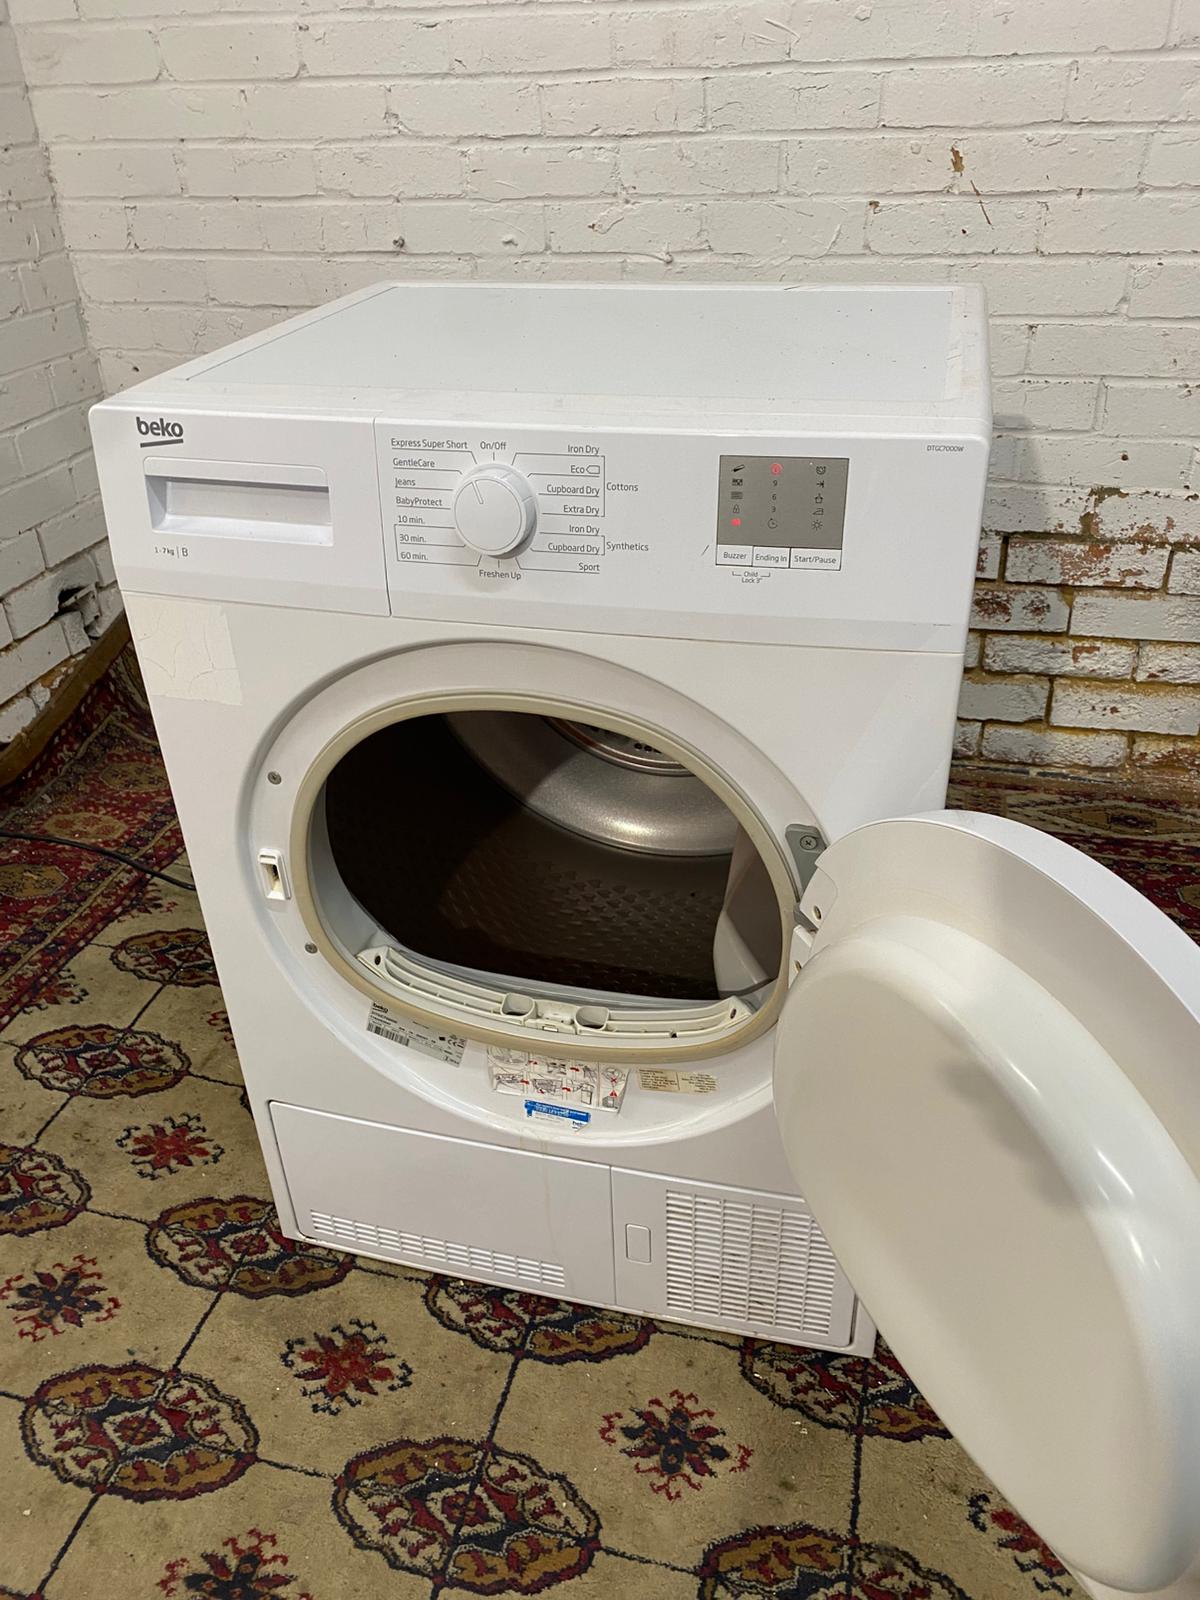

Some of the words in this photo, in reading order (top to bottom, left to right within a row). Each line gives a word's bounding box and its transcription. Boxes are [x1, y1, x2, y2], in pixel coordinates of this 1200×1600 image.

[136, 416, 184, 438] beko
[391, 438, 421, 449] Express
[422, 439, 445, 450] Super
[446, 440, 468, 449] Short
[480, 441, 507, 450] On/Off
[567, 444, 583, 453] Iron
[584, 445, 600, 456] Dry
[392, 458, 435, 468] GentleCare
[570, 465, 585, 474] Eco
[394, 477, 416, 488] Jeans
[606, 482, 639, 492] Cottons
[546, 484, 584, 496] Cupboard
[585, 486, 600, 497] Dry
[395, 496, 443, 507] BabyProtect
[563, 504, 584, 514] Extra
[585, 505, 600, 516] Dry
[398, 514, 407, 523] 10
[408, 516, 425, 525] min.
[569, 524, 584, 534] Iron
[585, 525, 600, 536] Dry
[399, 533, 409, 542] 30
[409, 534, 426, 543] min.
[547, 542, 585, 554] Cupboard
[585, 544, 600, 555] Dry
[606, 541, 649, 553] Synthetics
[401, 551, 410, 560] 60
[411, 553, 428, 561] min.
[723, 551, 747, 560] Buzzer
[755, 553, 779, 565] Ending
[780, 554, 787, 563] In
[793, 555, 837, 565] Start/Pause
[578, 562, 600, 573] Sport
[479, 569, 510, 579] Freshen
[510, 571, 522, 581] Up
